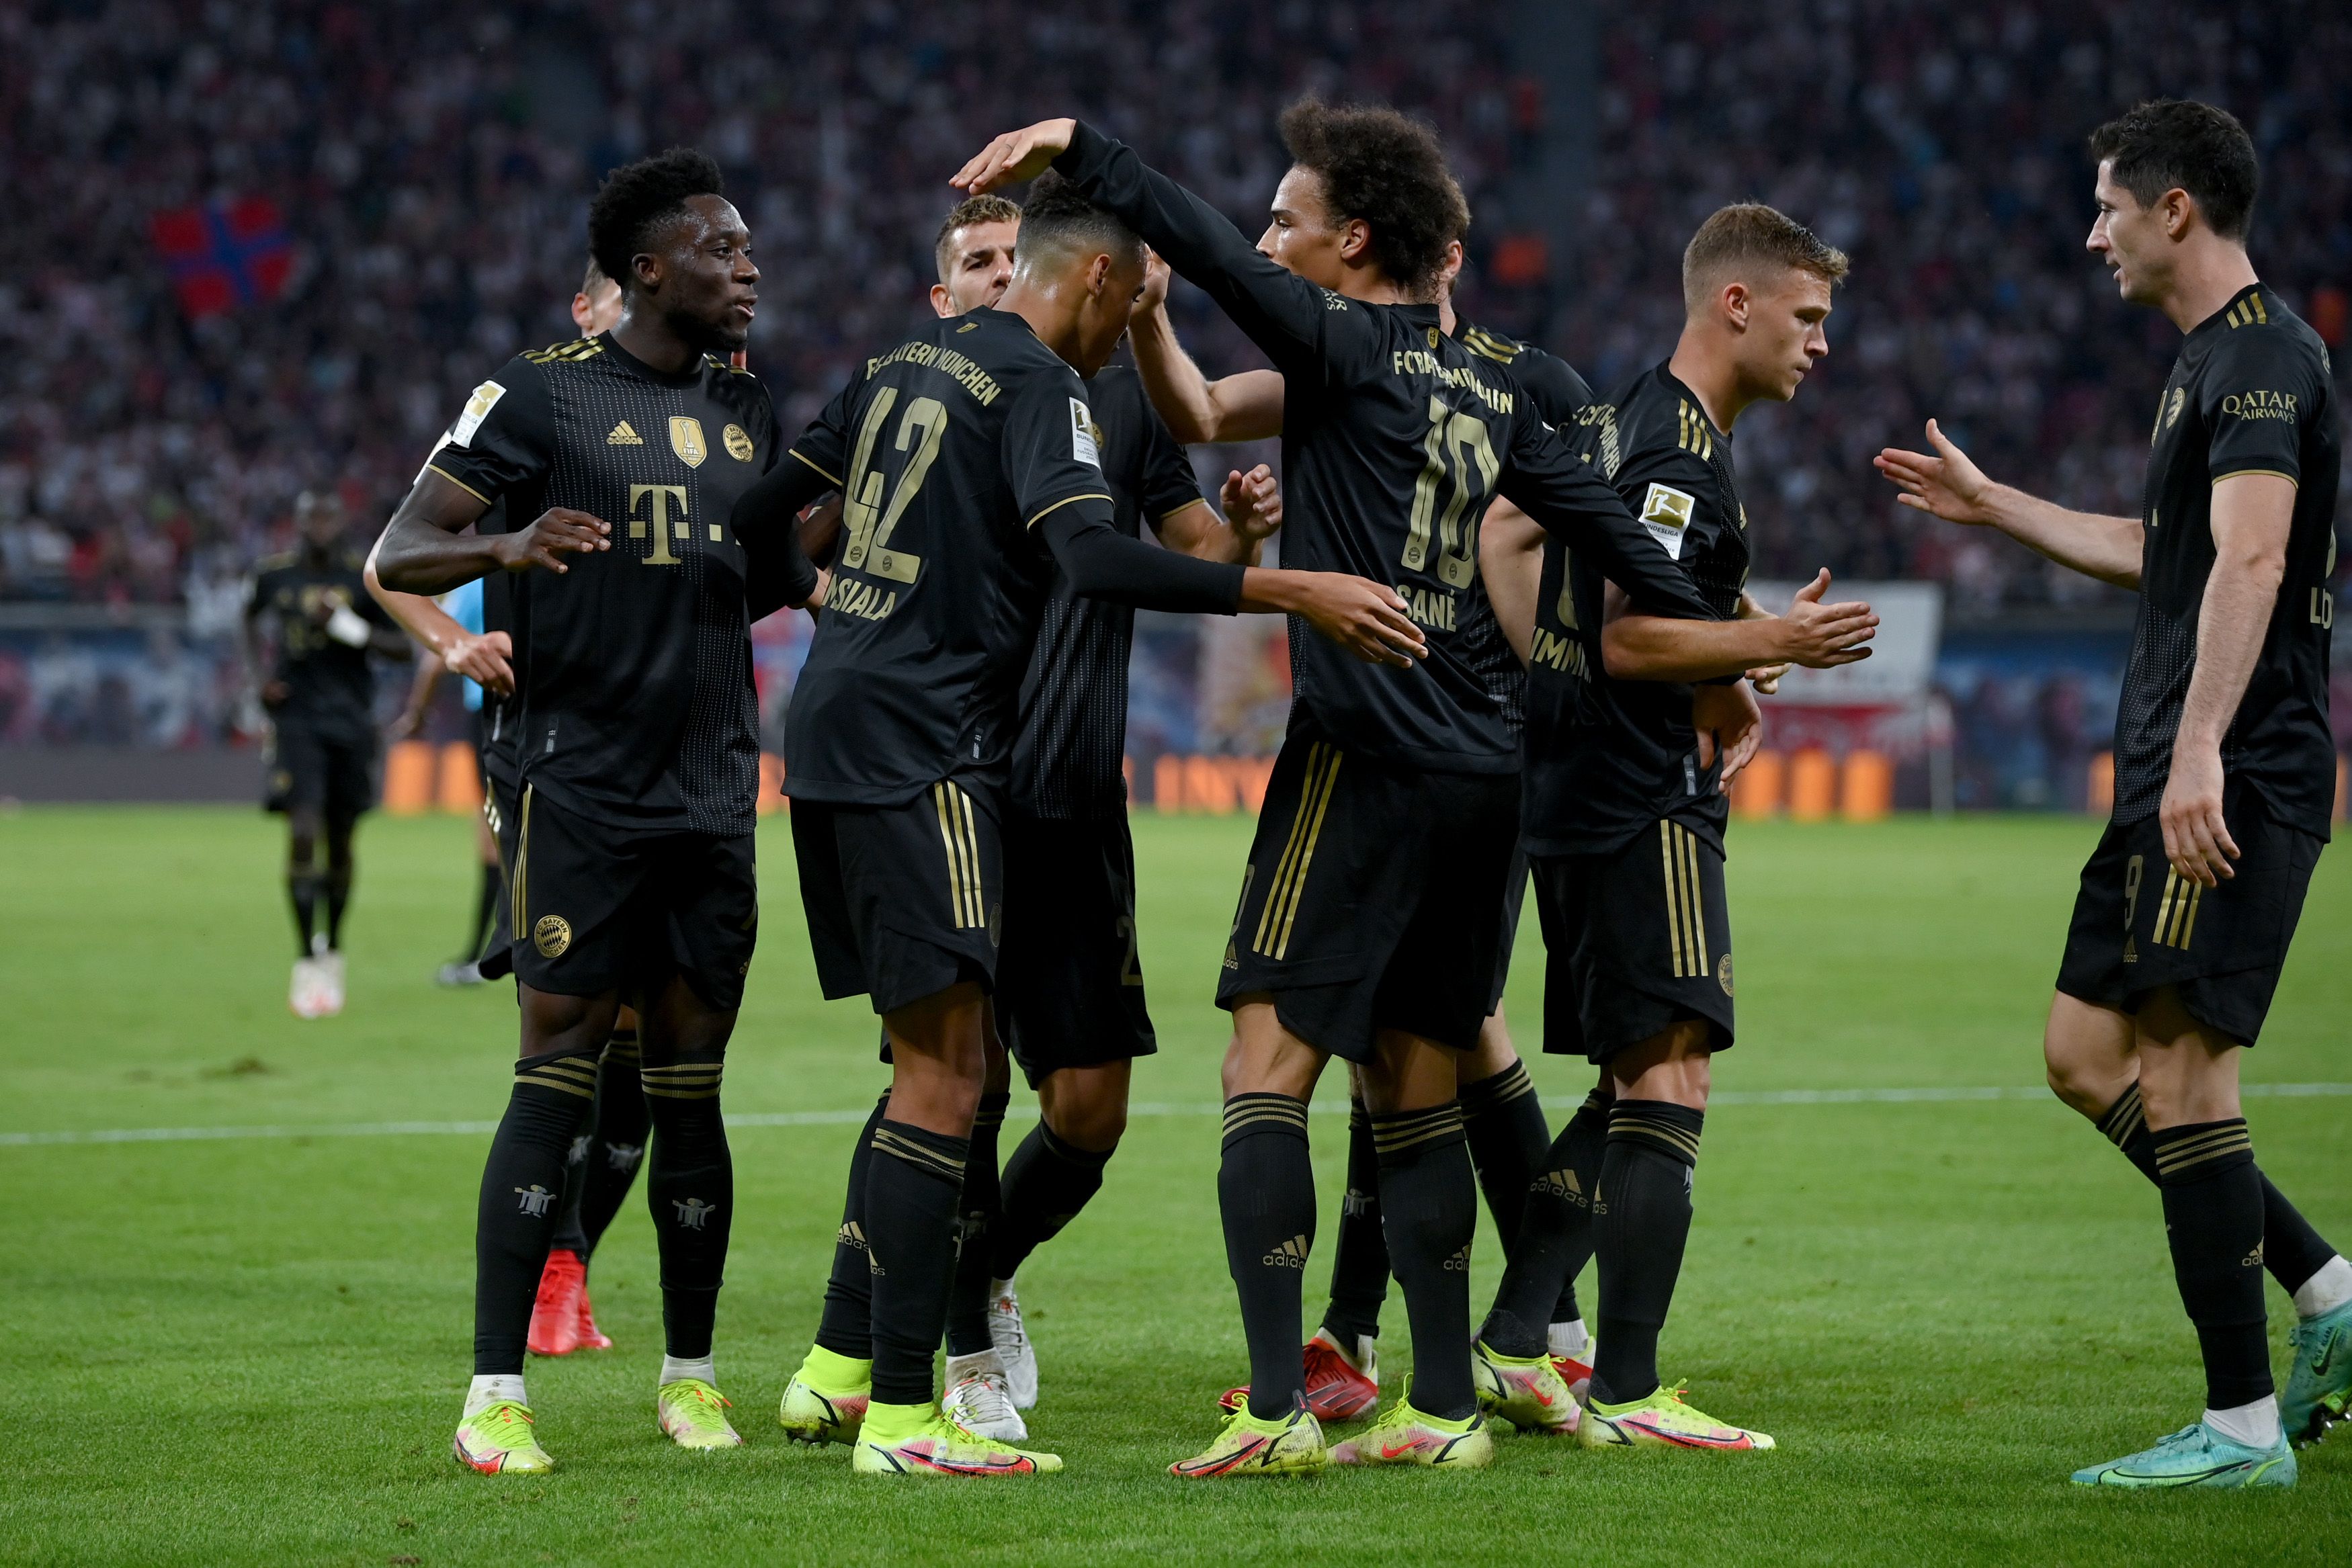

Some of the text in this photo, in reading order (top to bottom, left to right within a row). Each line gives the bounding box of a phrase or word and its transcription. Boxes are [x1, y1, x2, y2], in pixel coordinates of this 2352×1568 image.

[1393, 350, 1415, 375] FC
[2222, 390, 2297, 415] QATAR
[2241, 408, 2295, 425] AIRWAYS
[683, 447, 700, 455] FIFA
[842, 386, 948, 585] 42
[1401, 394, 1500, 590] 10
[1644, 523, 1679, 537] UNDESLIGA
[822, 573, 896, 621] MSIALA
[1396, 584, 1456, 632] SANÉ
[543, 918, 568, 933] BAYERN
[1530, 1178, 1589, 1208] adidas
[838, 1233, 870, 1253] didas
[1263, 1252, 1304, 1270] adida
